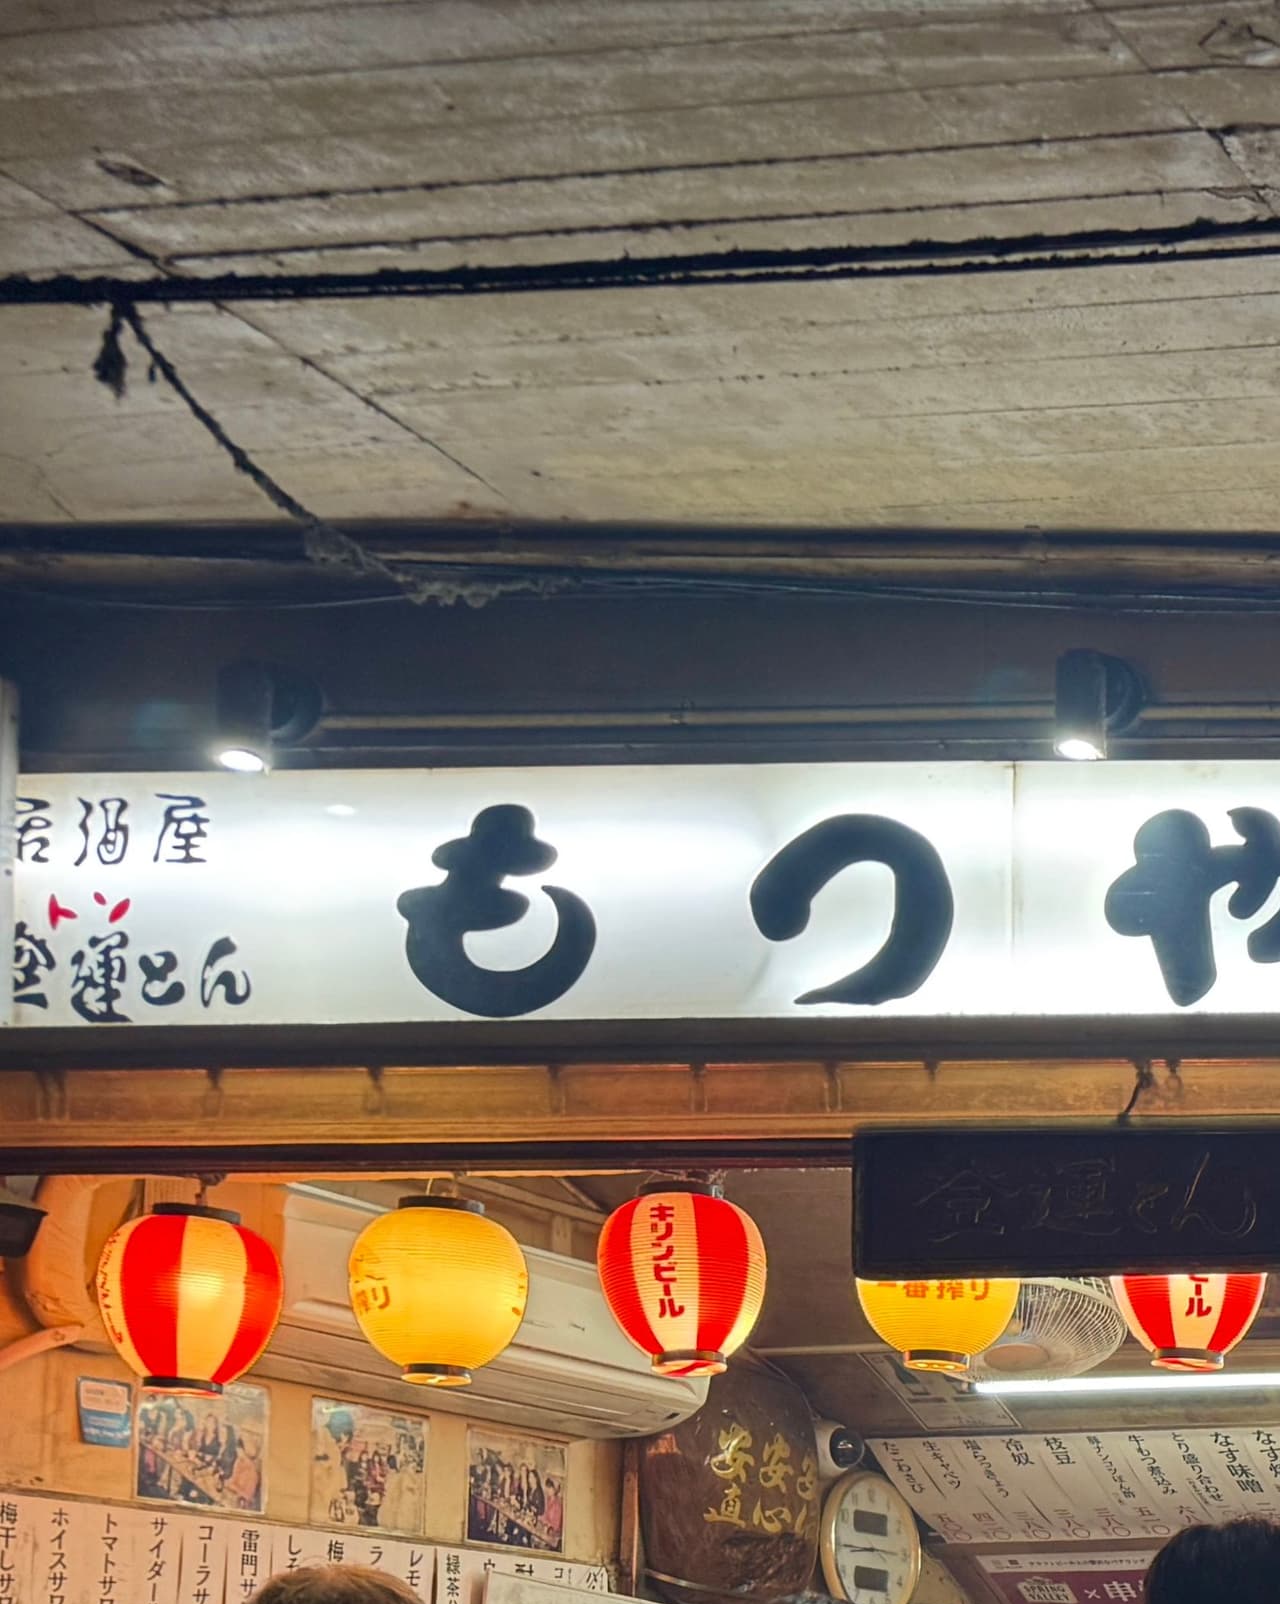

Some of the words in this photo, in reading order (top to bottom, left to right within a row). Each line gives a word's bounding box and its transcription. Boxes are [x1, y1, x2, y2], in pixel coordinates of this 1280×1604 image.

[649, 1203, 685, 1318] キリンビール
[1002, 1437, 1034, 1466] 冷奴
[1044, 1436, 1075, 1465] 枝豆
[1128, 1434, 1178, 1495] 牛もつ煮込み
[1210, 1431, 1264, 1494] なす味噌
[240, 1529, 260, 1602] 雷門サ
